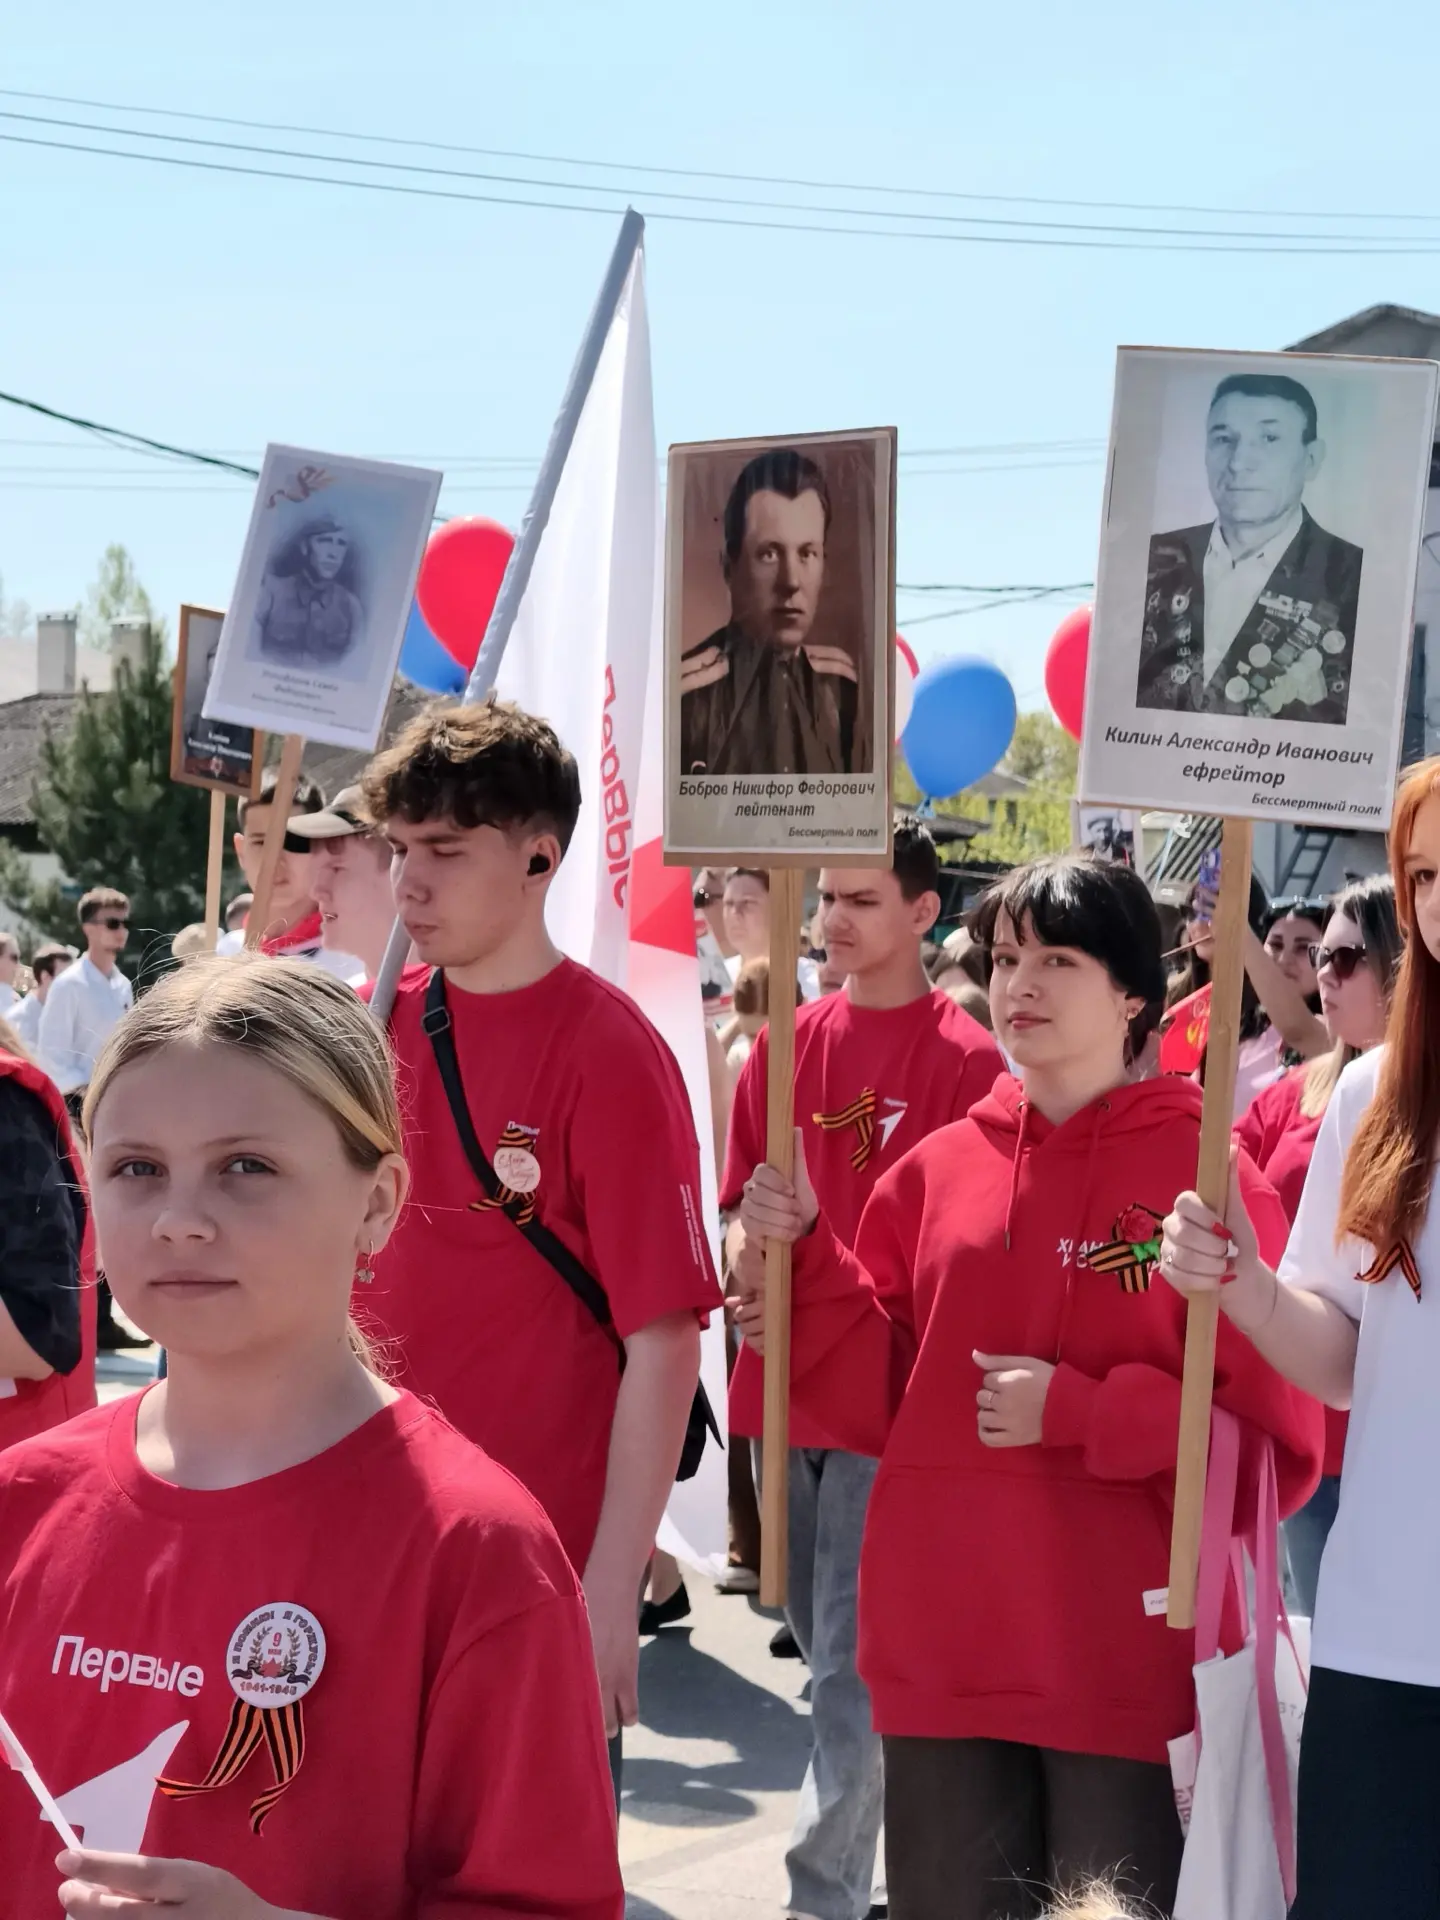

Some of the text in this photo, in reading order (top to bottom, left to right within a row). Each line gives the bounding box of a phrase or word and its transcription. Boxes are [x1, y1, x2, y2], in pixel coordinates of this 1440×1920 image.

[1104, 726, 1374, 764] Килин Александр Иванович
[600, 663, 632, 908] Первы
[1182, 762, 1286, 787] ефрейтор
[679, 780, 875, 799] Бобров Никифор Федорович
[735, 803, 816, 817] лейтенант
[1251, 792, 1383, 816] Бессмертный полк
[788, 827, 879, 838] Бессмертный полк
[272, 1632, 282, 1647] 9
[51, 1634, 204, 1698] Первые
